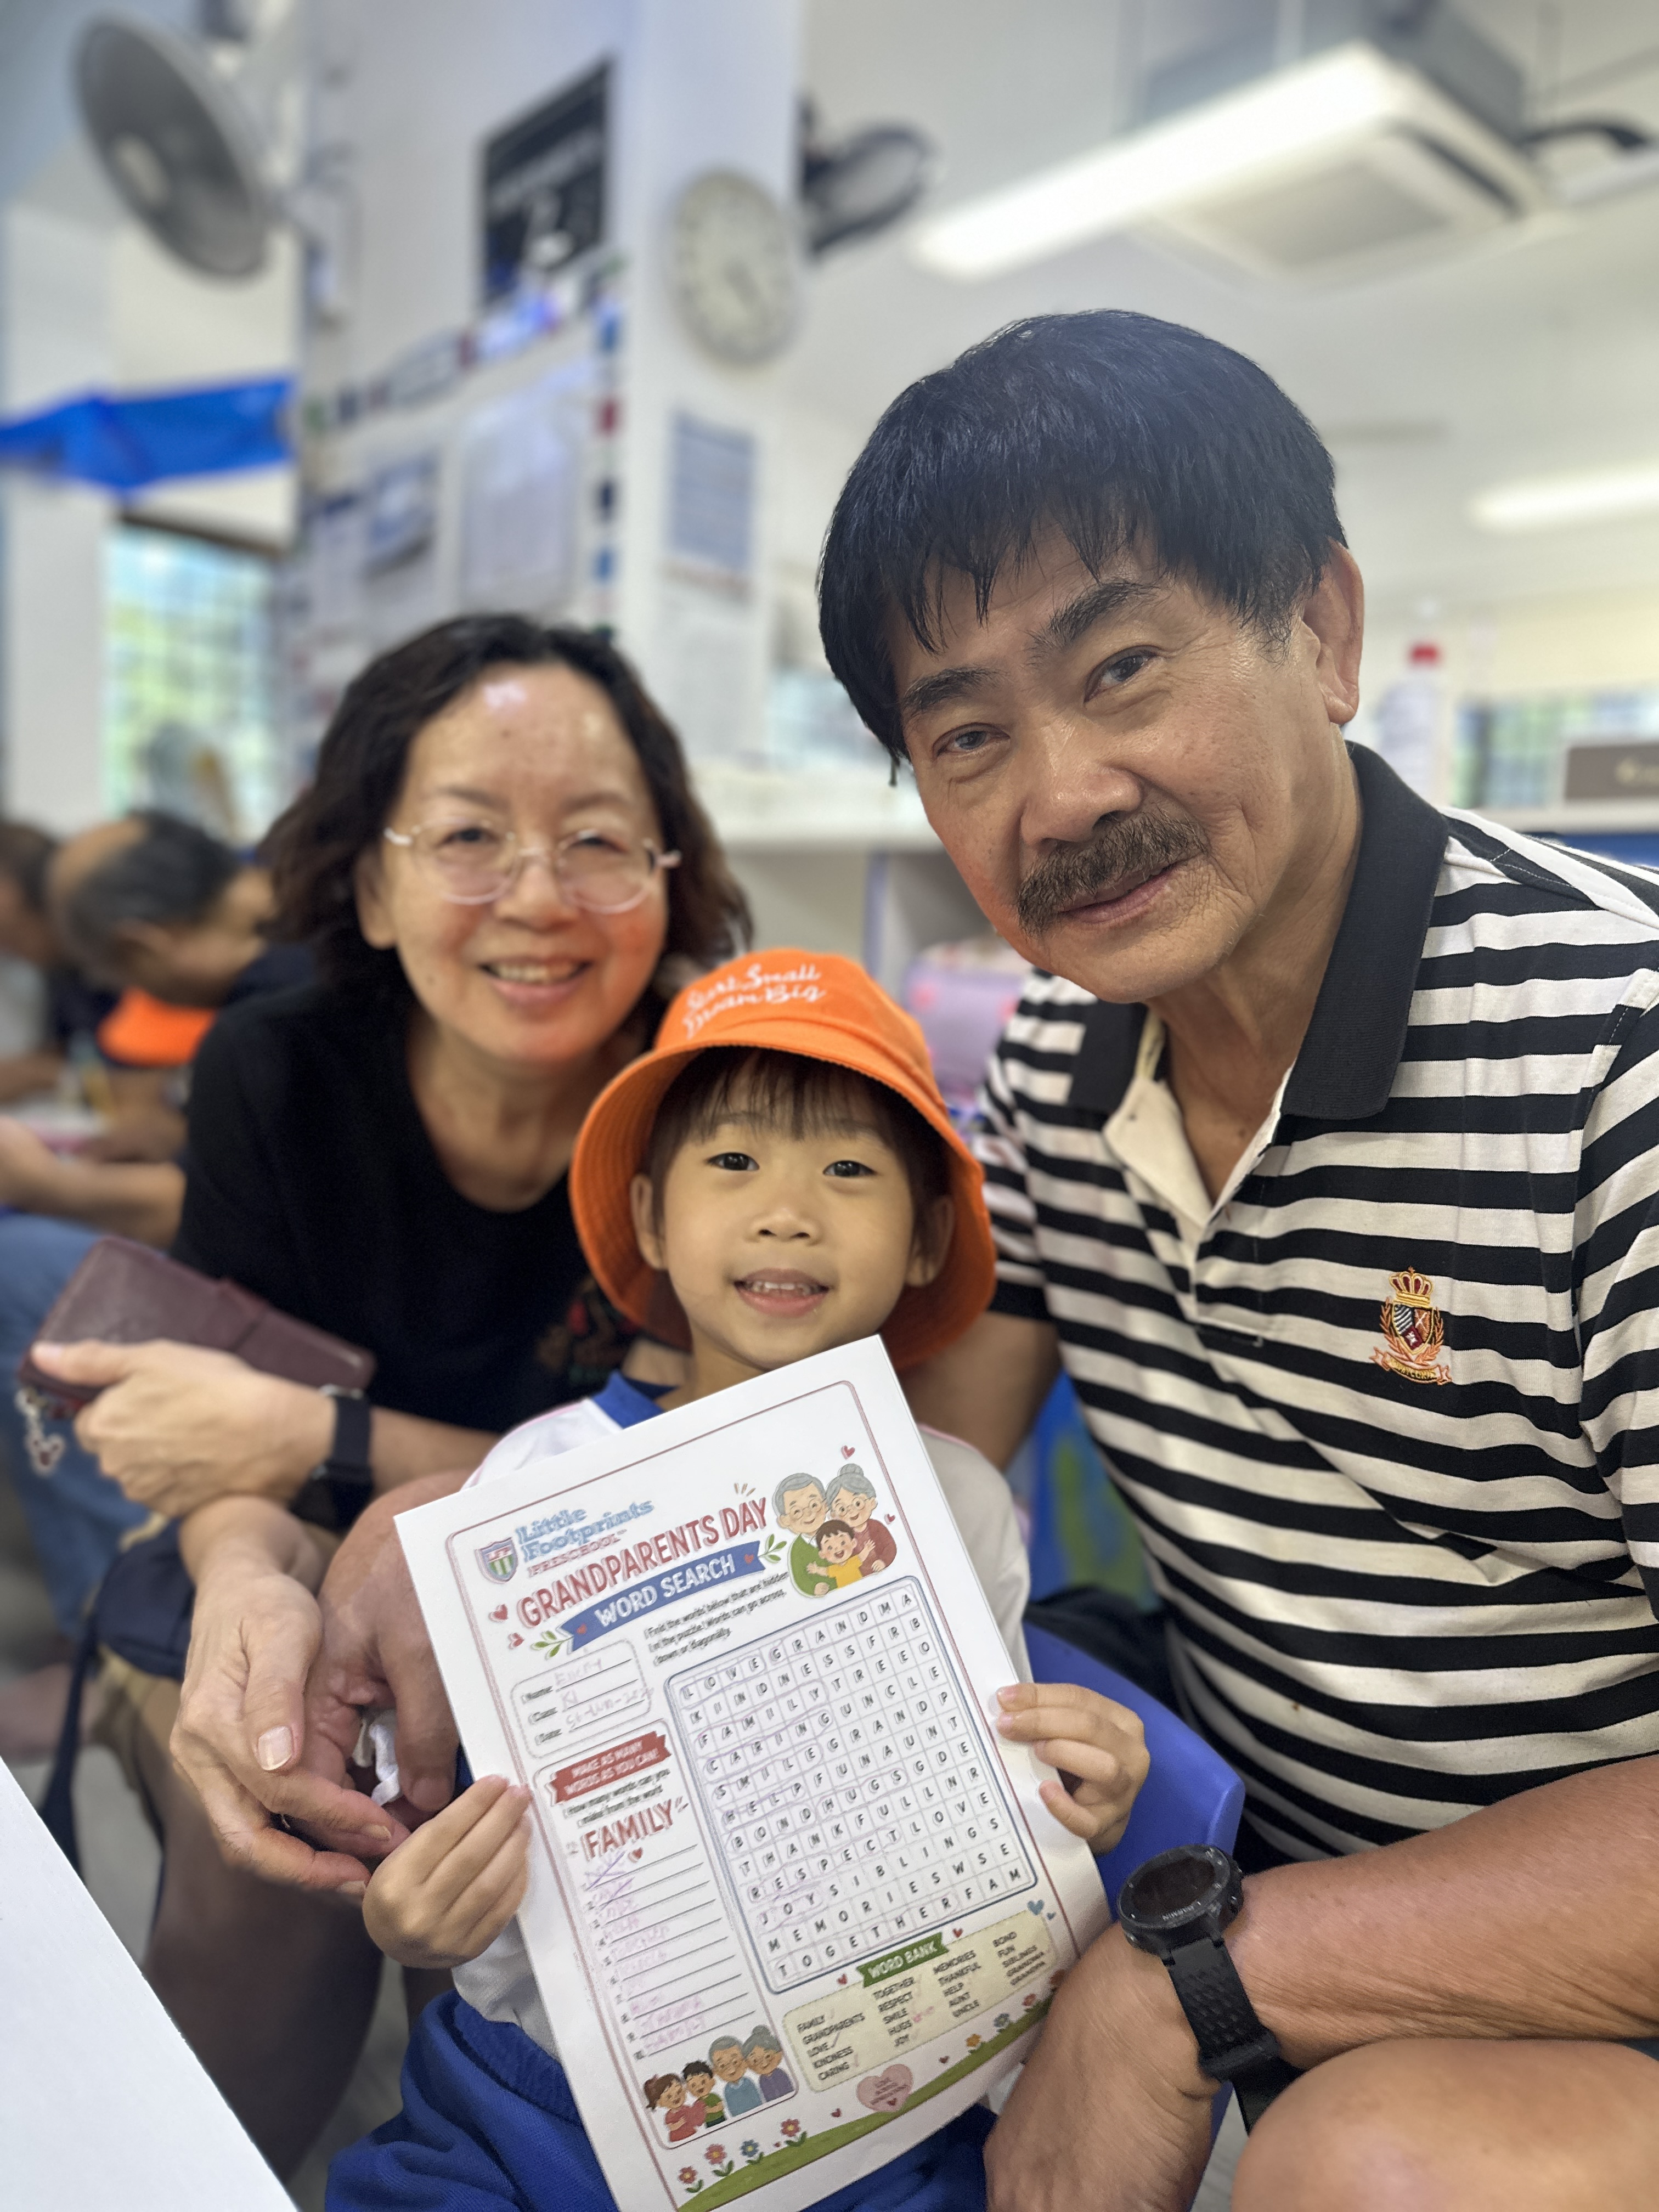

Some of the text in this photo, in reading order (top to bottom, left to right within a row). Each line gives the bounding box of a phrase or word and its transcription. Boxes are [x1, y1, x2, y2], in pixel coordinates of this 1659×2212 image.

[745, 963, 822, 988] Small
[765, 984, 826, 1005] Big
[516, 1509, 588, 1544] Little
[521, 1500, 654, 1562] Footprints
[517, 1497, 766, 1629] GRANDPARENTS DAY
[528, 1533, 621, 1577] PRESCHOOL
[594, 1554, 736, 1627] WORD SEARCH
[581, 1799, 673, 1860] FAMILY
[992, 1931, 1017, 1947] BOND
[868, 1940, 938, 1978] WORD BANK
[932, 1950, 977, 1974] MEMORIES
[997, 1945, 1015, 1958] FUN
[938, 1962, 981, 1987] THANKFUL
[872, 1976, 915, 2000] TOGETHER
[942, 1982, 964, 1997] HELP
[878, 1991, 913, 2013] RESPECT
[949, 1991, 970, 2008] AUNT
[952, 2000, 979, 2018] UNCLE
[797, 2015, 825, 2033] FAMILY
[883, 2008, 908, 2024] SMILE
[803, 2012, 865, 2045] GRANDPARENTS
[888, 2020, 912, 2036] HUGS
[807, 2042, 830, 2058] LOVE
[894, 2034, 910, 2047] JOY
[812, 2046, 854, 2069] KINDNESS
[818, 2062, 850, 2080] CARING
